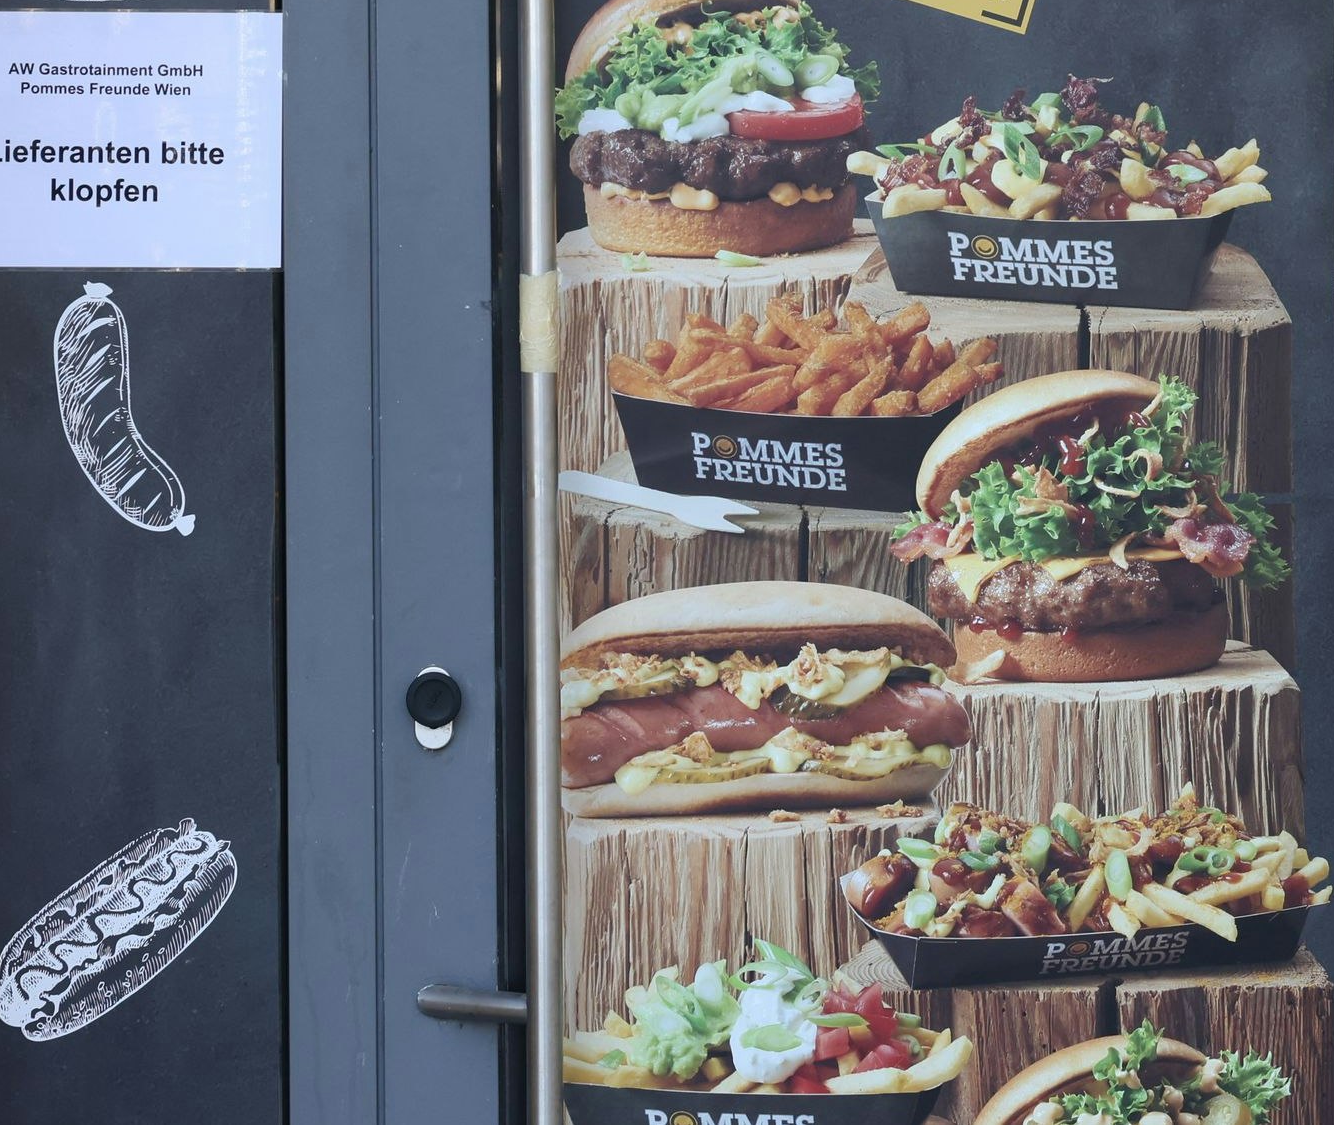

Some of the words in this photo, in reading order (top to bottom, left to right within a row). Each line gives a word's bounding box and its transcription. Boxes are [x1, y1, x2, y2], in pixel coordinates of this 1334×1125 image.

[8, 63, 35, 76] AW
[39, 63, 153, 77] Gastrotainment
[158, 64, 204, 77] GmbH
[20, 82, 84, 95] Pommes
[89, 82, 150, 96] Freunde
[154, 83, 191, 96] Wien
[161, 141, 225, 165] bitte
[51, 179, 159, 207] klopfen
[947, 231, 1114, 265] POMMES
[951, 257, 1118, 289] FREUNDE
[691, 432, 844, 467] POMMES
[694, 457, 847, 491] FREUNDE
[1039, 949, 1186, 975] FREUNDE
